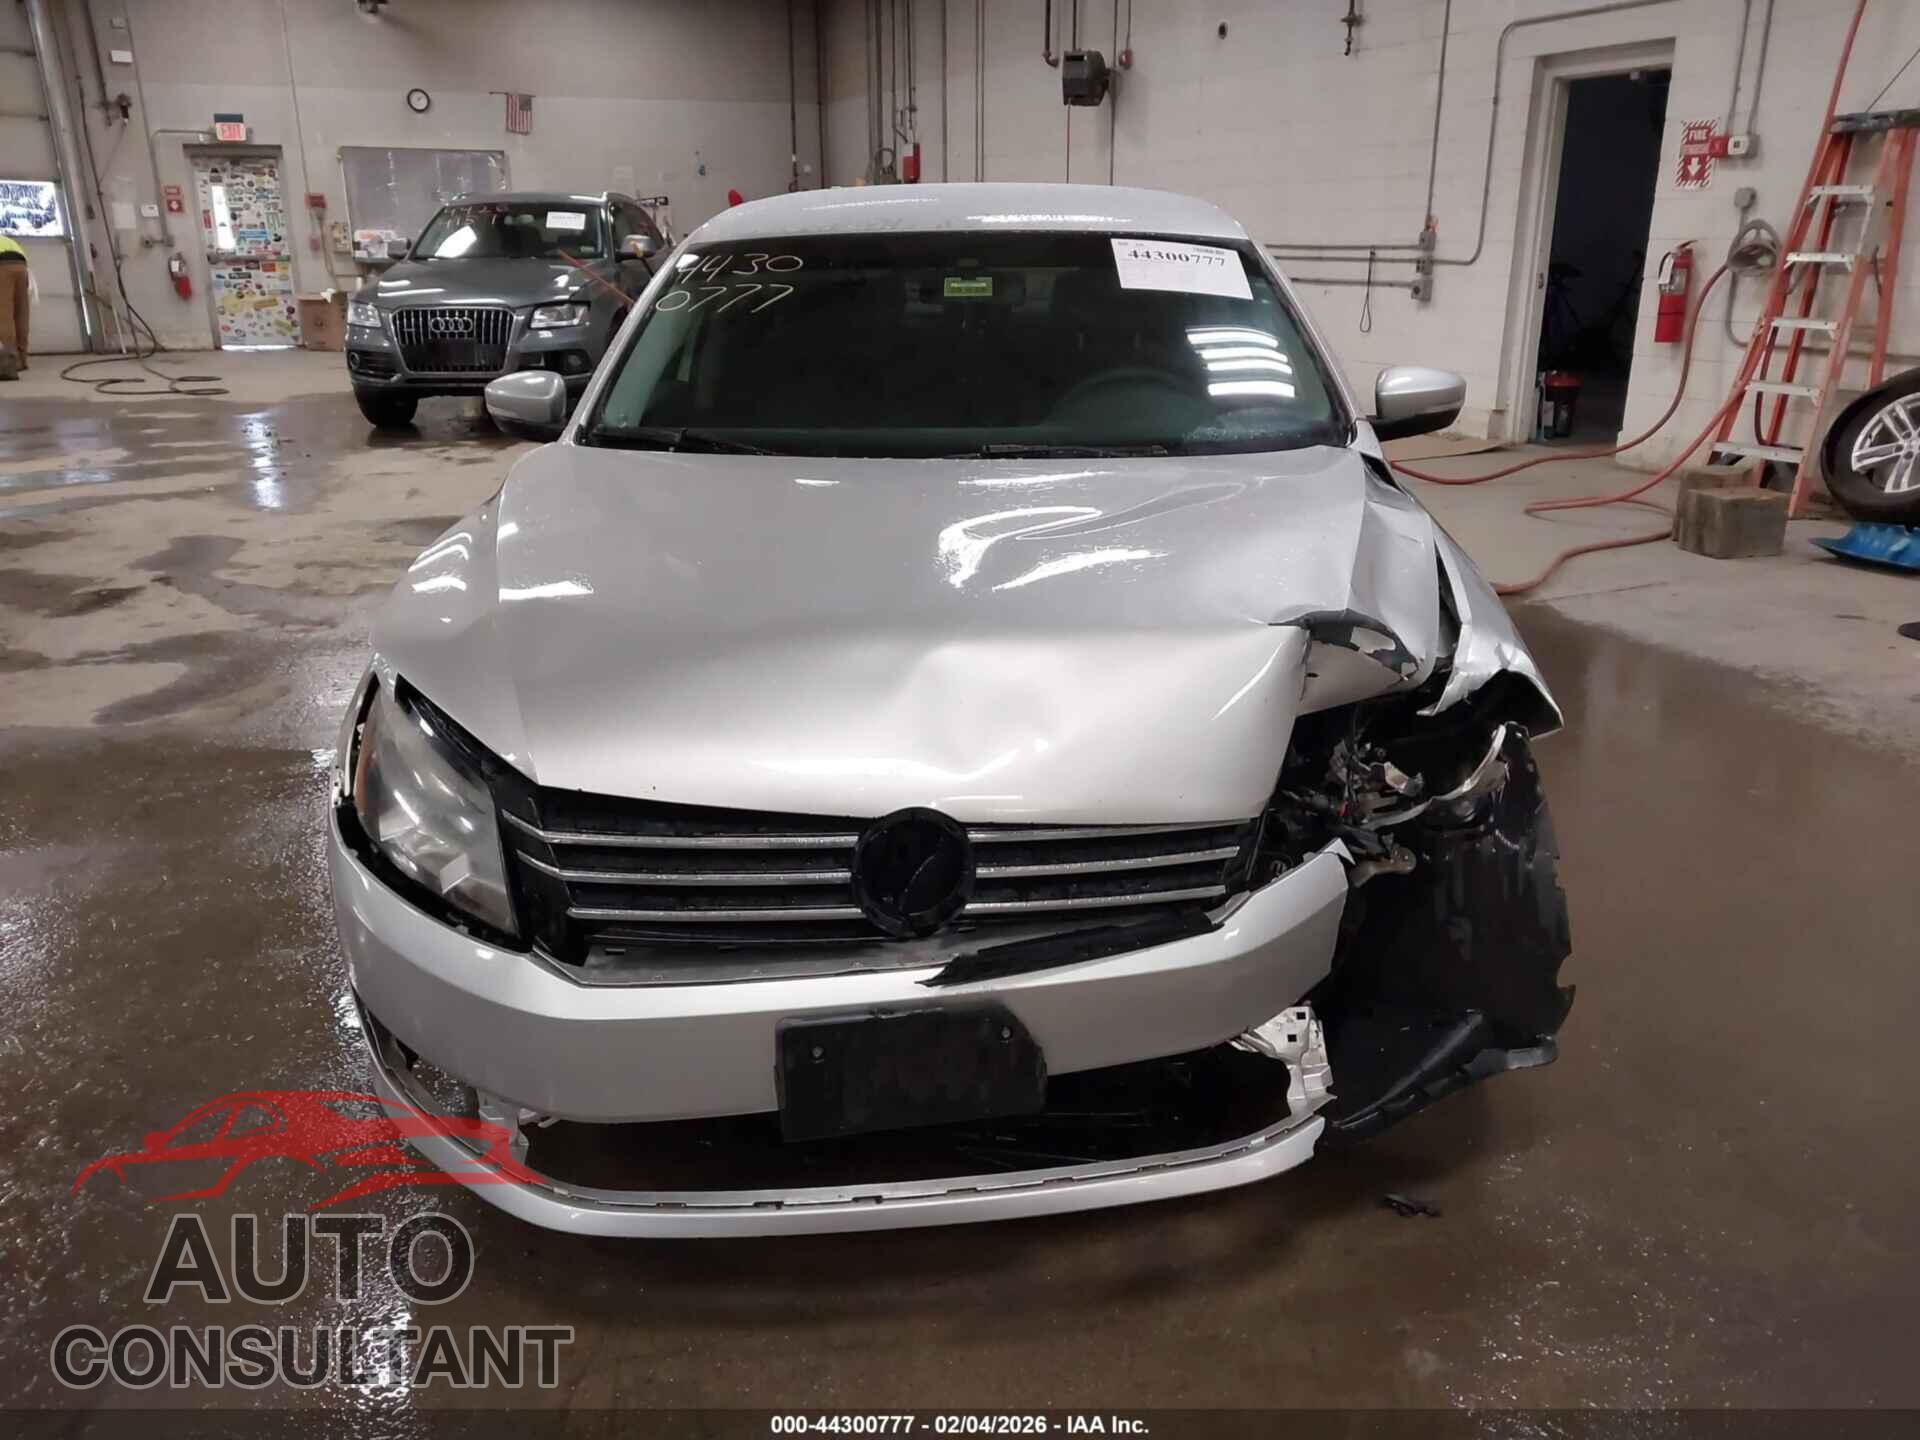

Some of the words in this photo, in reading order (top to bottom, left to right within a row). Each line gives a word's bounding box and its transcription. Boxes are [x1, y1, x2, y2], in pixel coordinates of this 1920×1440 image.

[1688, 129, 1710, 141] FIRE
[676, 253, 804, 284] 4430
[1127, 249, 1226, 267] 44300777
[655, 284, 794, 313] 0777
